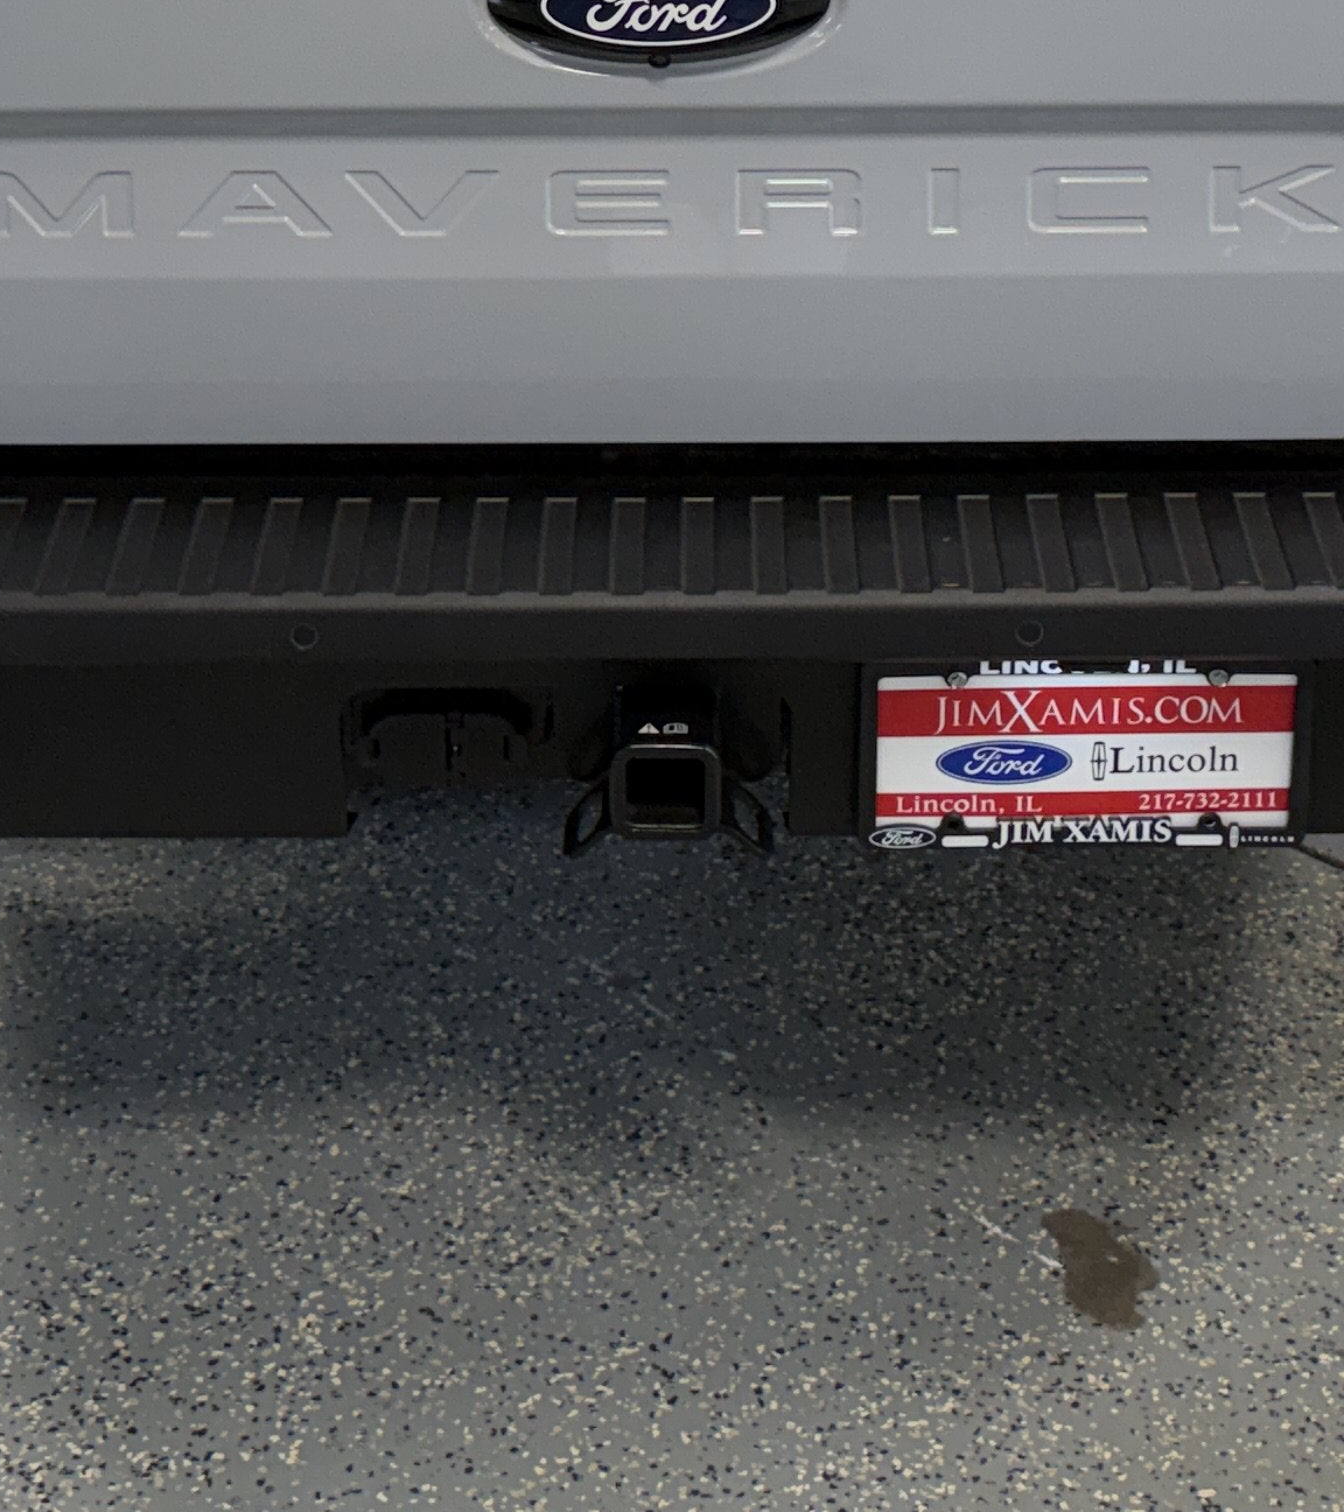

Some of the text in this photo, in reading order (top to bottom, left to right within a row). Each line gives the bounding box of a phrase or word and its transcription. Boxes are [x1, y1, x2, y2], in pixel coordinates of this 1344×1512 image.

[1163, 659, 1197, 674] IL
[934, 690, 1243, 735] JIMXAMIS.COM
[963, 746, 1043, 777] Ford
[1110, 746, 1239, 774] Lincoln
[896, 795, 1042, 814] Lincoln, IL
[1139, 792, 1277, 810] 217-732-2111
[881, 831, 923, 846] Ford
[992, 818, 1173, 849] JIM XAMIS
[1241, 835, 1295, 843] LINCOLN
